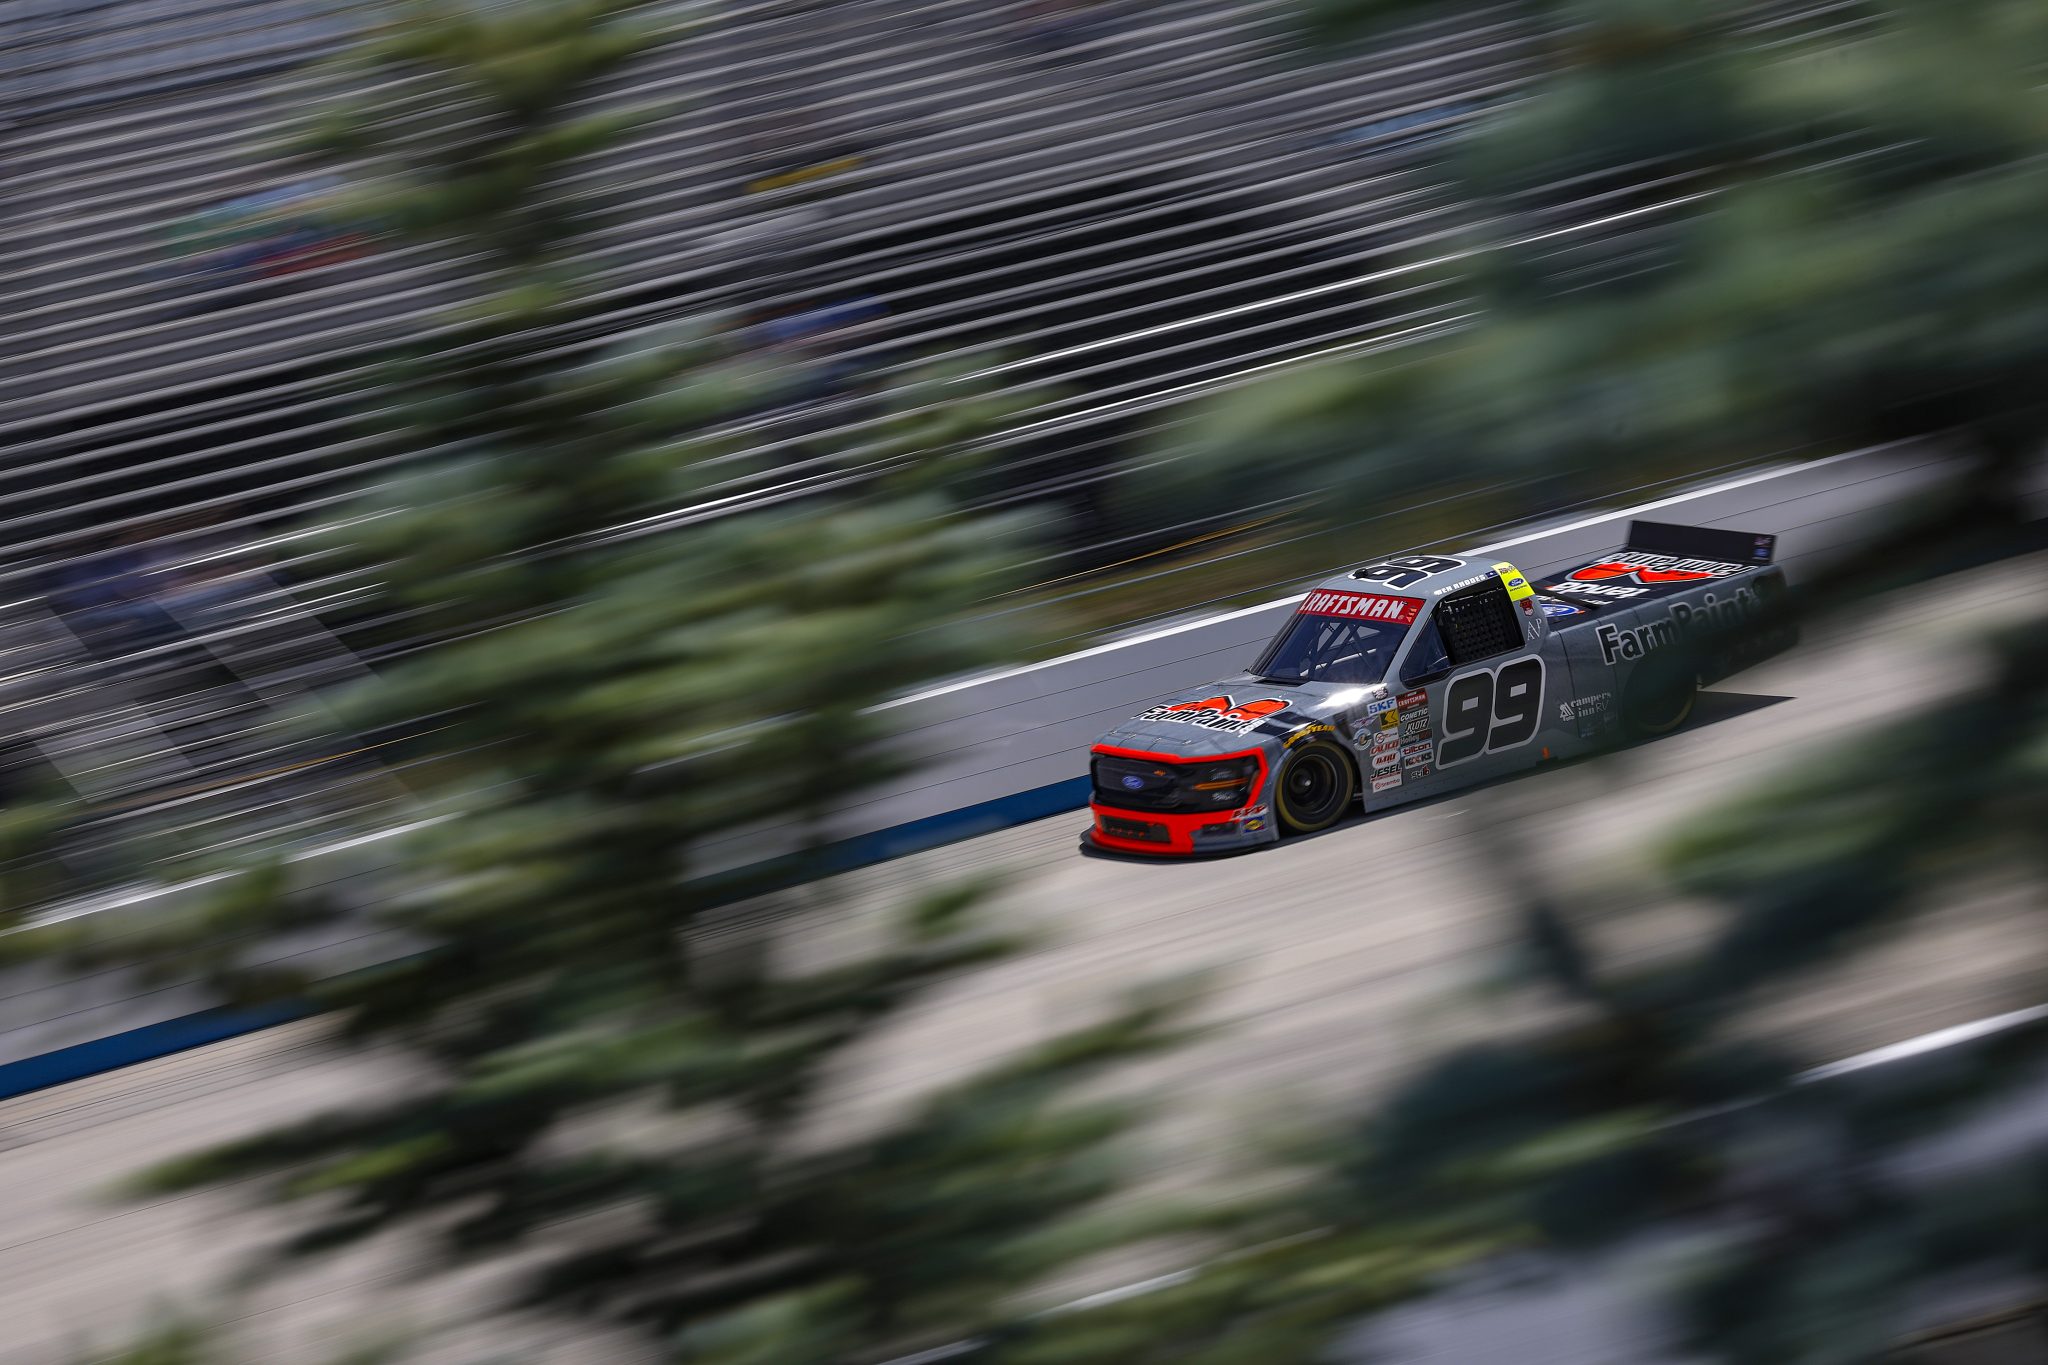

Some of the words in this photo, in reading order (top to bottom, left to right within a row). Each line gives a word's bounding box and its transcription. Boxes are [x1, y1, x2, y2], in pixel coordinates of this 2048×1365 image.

[1348, 555, 1467, 590] 99
[1369, 698, 1395, 714] SKF
[1436, 654, 1546, 770] 99
[1400, 708, 1428, 722] COMETIC
[1405, 718, 1428, 733] KLOTZ
[1371, 765, 1400, 779] JESEL
